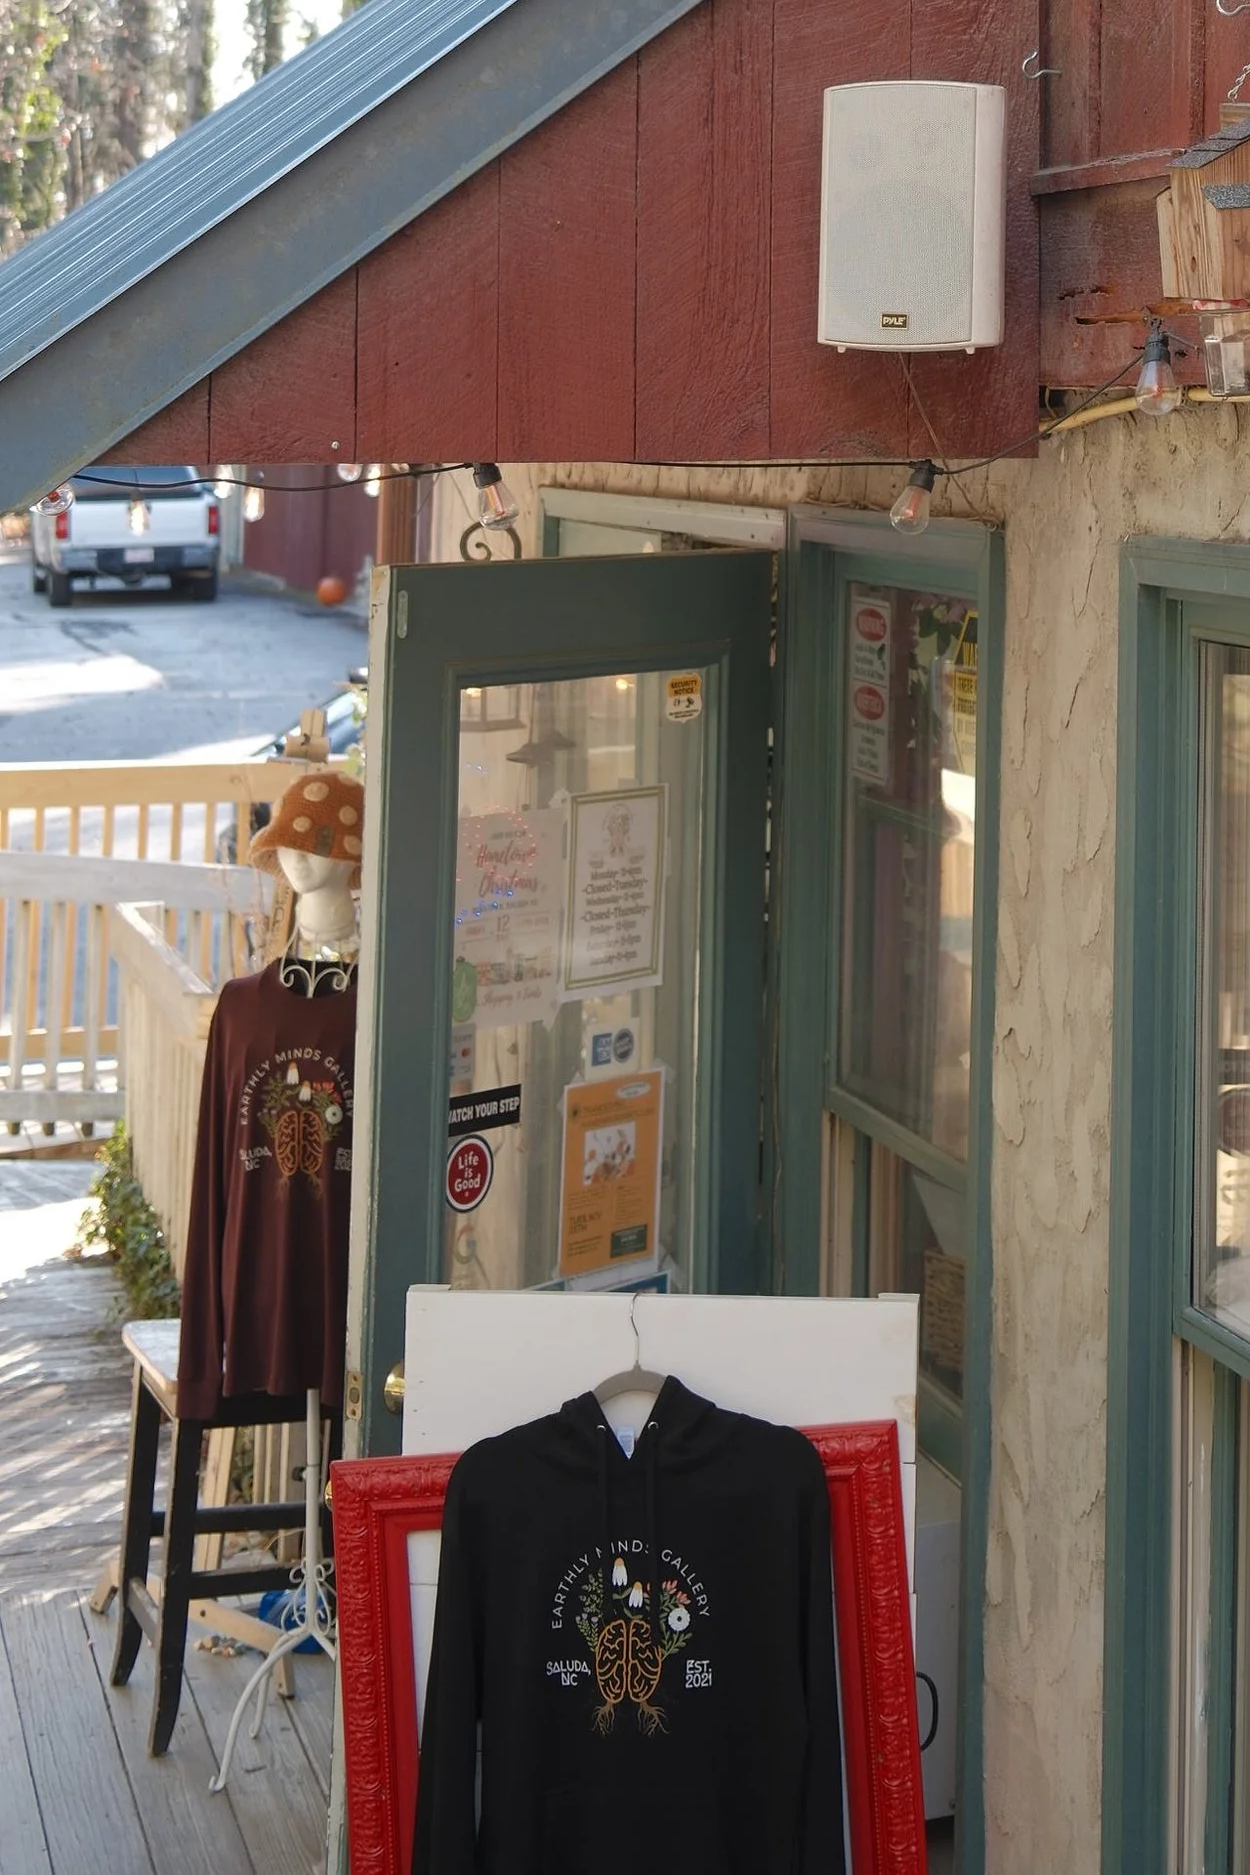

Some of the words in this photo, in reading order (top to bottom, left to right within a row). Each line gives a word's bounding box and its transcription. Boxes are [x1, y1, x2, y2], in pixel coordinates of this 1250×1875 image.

[882, 315, 906, 325] PYLE
[274, 1047, 322, 1064] MINDS
[474, 1100, 498, 1119] YOUR
[499, 1096, 520, 1114] STEP
[458, 1151, 480, 1170] Life
[464, 1167, 474, 1178] is
[454, 1173, 481, 1192] Good
[551, 1554, 590, 1629] EARTHLY
[661, 1549, 711, 1617] GALLERY
[546, 1659, 592, 1676] SALUDA,
[685, 1659, 713, 1674] EST.
[561, 1674, 579, 1686] NC
[685, 1673, 713, 1689] 2021
